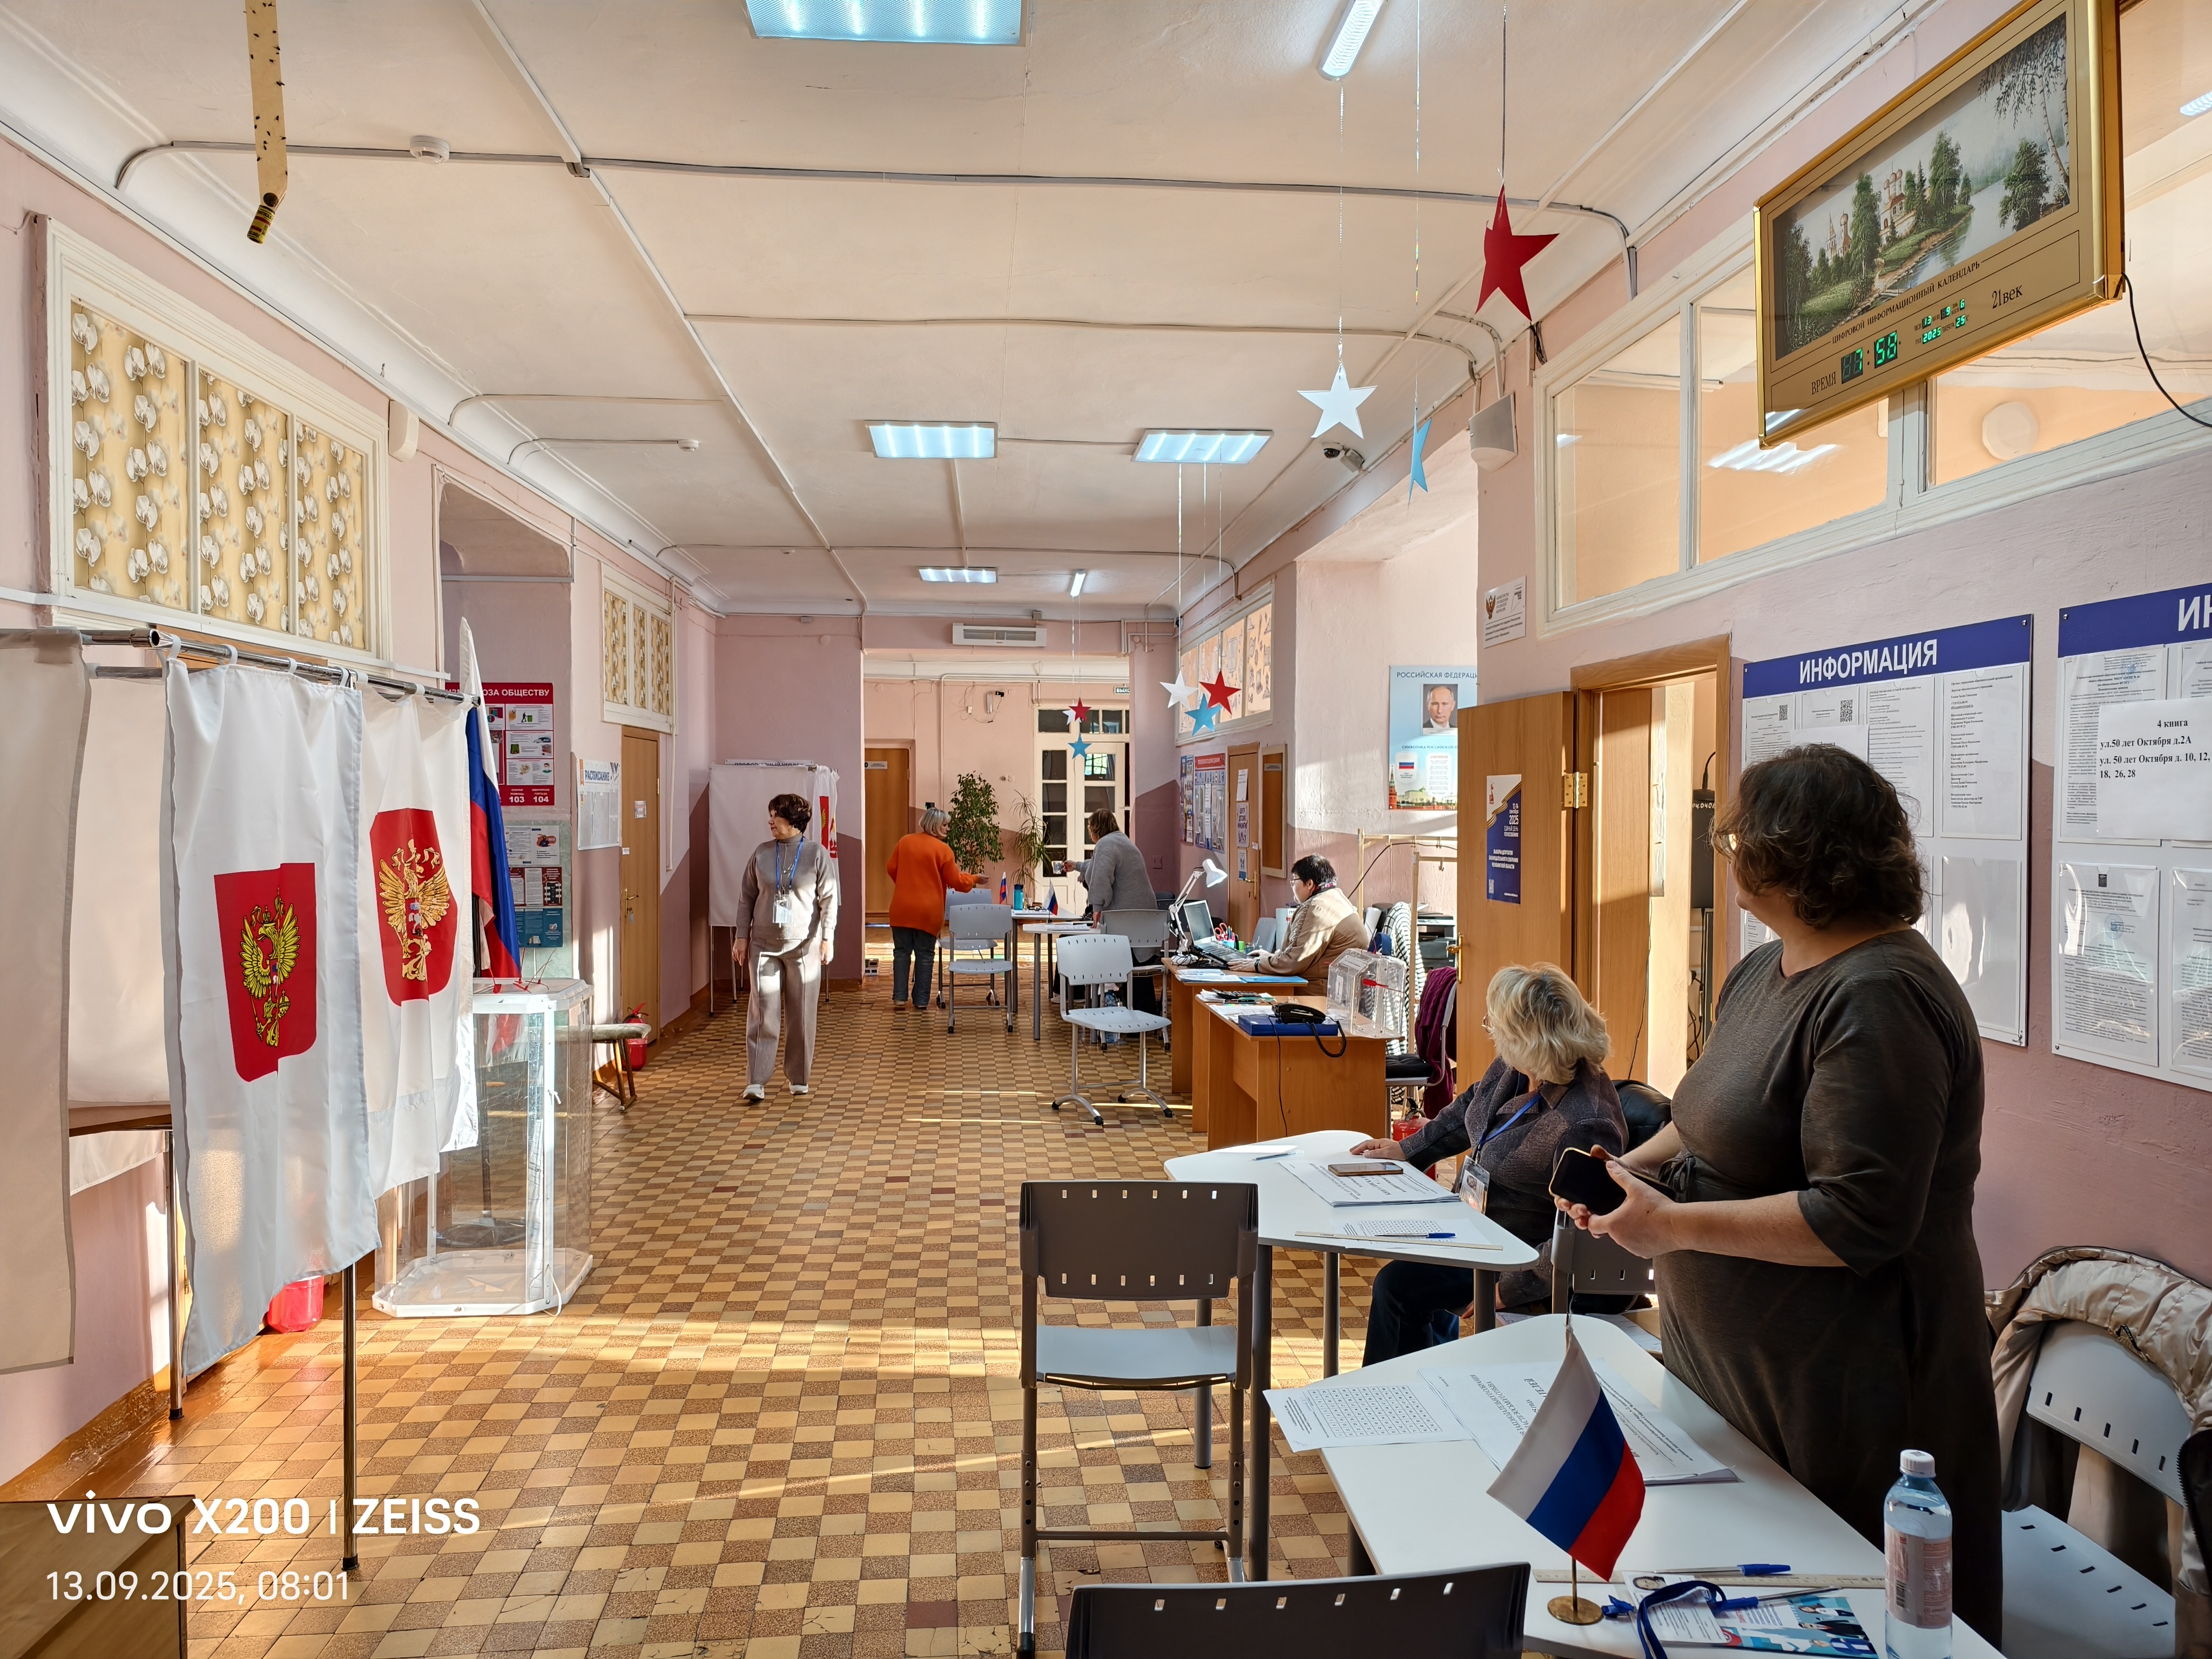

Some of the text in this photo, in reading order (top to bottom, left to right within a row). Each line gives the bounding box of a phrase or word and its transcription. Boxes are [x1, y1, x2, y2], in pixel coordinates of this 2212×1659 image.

[1832, 320, 1865, 344] ЦИФРОВОЙ
[1867, 283, 1934, 327] ИНФОРМАЦИОННЫЙ
[1937, 261, 1980, 289] КАЛЕНДАРЬ
[1992, 285, 2023, 309] 21век
[1924, 315, 1932, 326] 13
[1960, 299, 1965, 308] 6
[1923, 327, 1941, 342] 2025
[1956, 315, 1965, 327] 25
[1811, 372, 1836, 395] ВРЕМЯ
[1800, 639, 1937, 684] ИНФОРМАЦИЯ
[2157, 720, 2188, 728] 4 книга
[2100, 739, 2120, 750] ул.50
[2137, 737, 2171, 747] Октября
[2173, 736, 2191, 745] д.2А
[2100, 757, 2111, 766] ул.
[2113, 756, 2122, 764] 50
[2139, 754, 2173, 764] Октября
[2185, 753, 2196, 763] 10,
[2199, 752, 2210, 762] 12,
[585, 770, 610, 781] РАСПИСАНИЕ
[2100, 770, 2136, 779] 18, 26, 28
[1509, 815, 1519, 825] 2025
